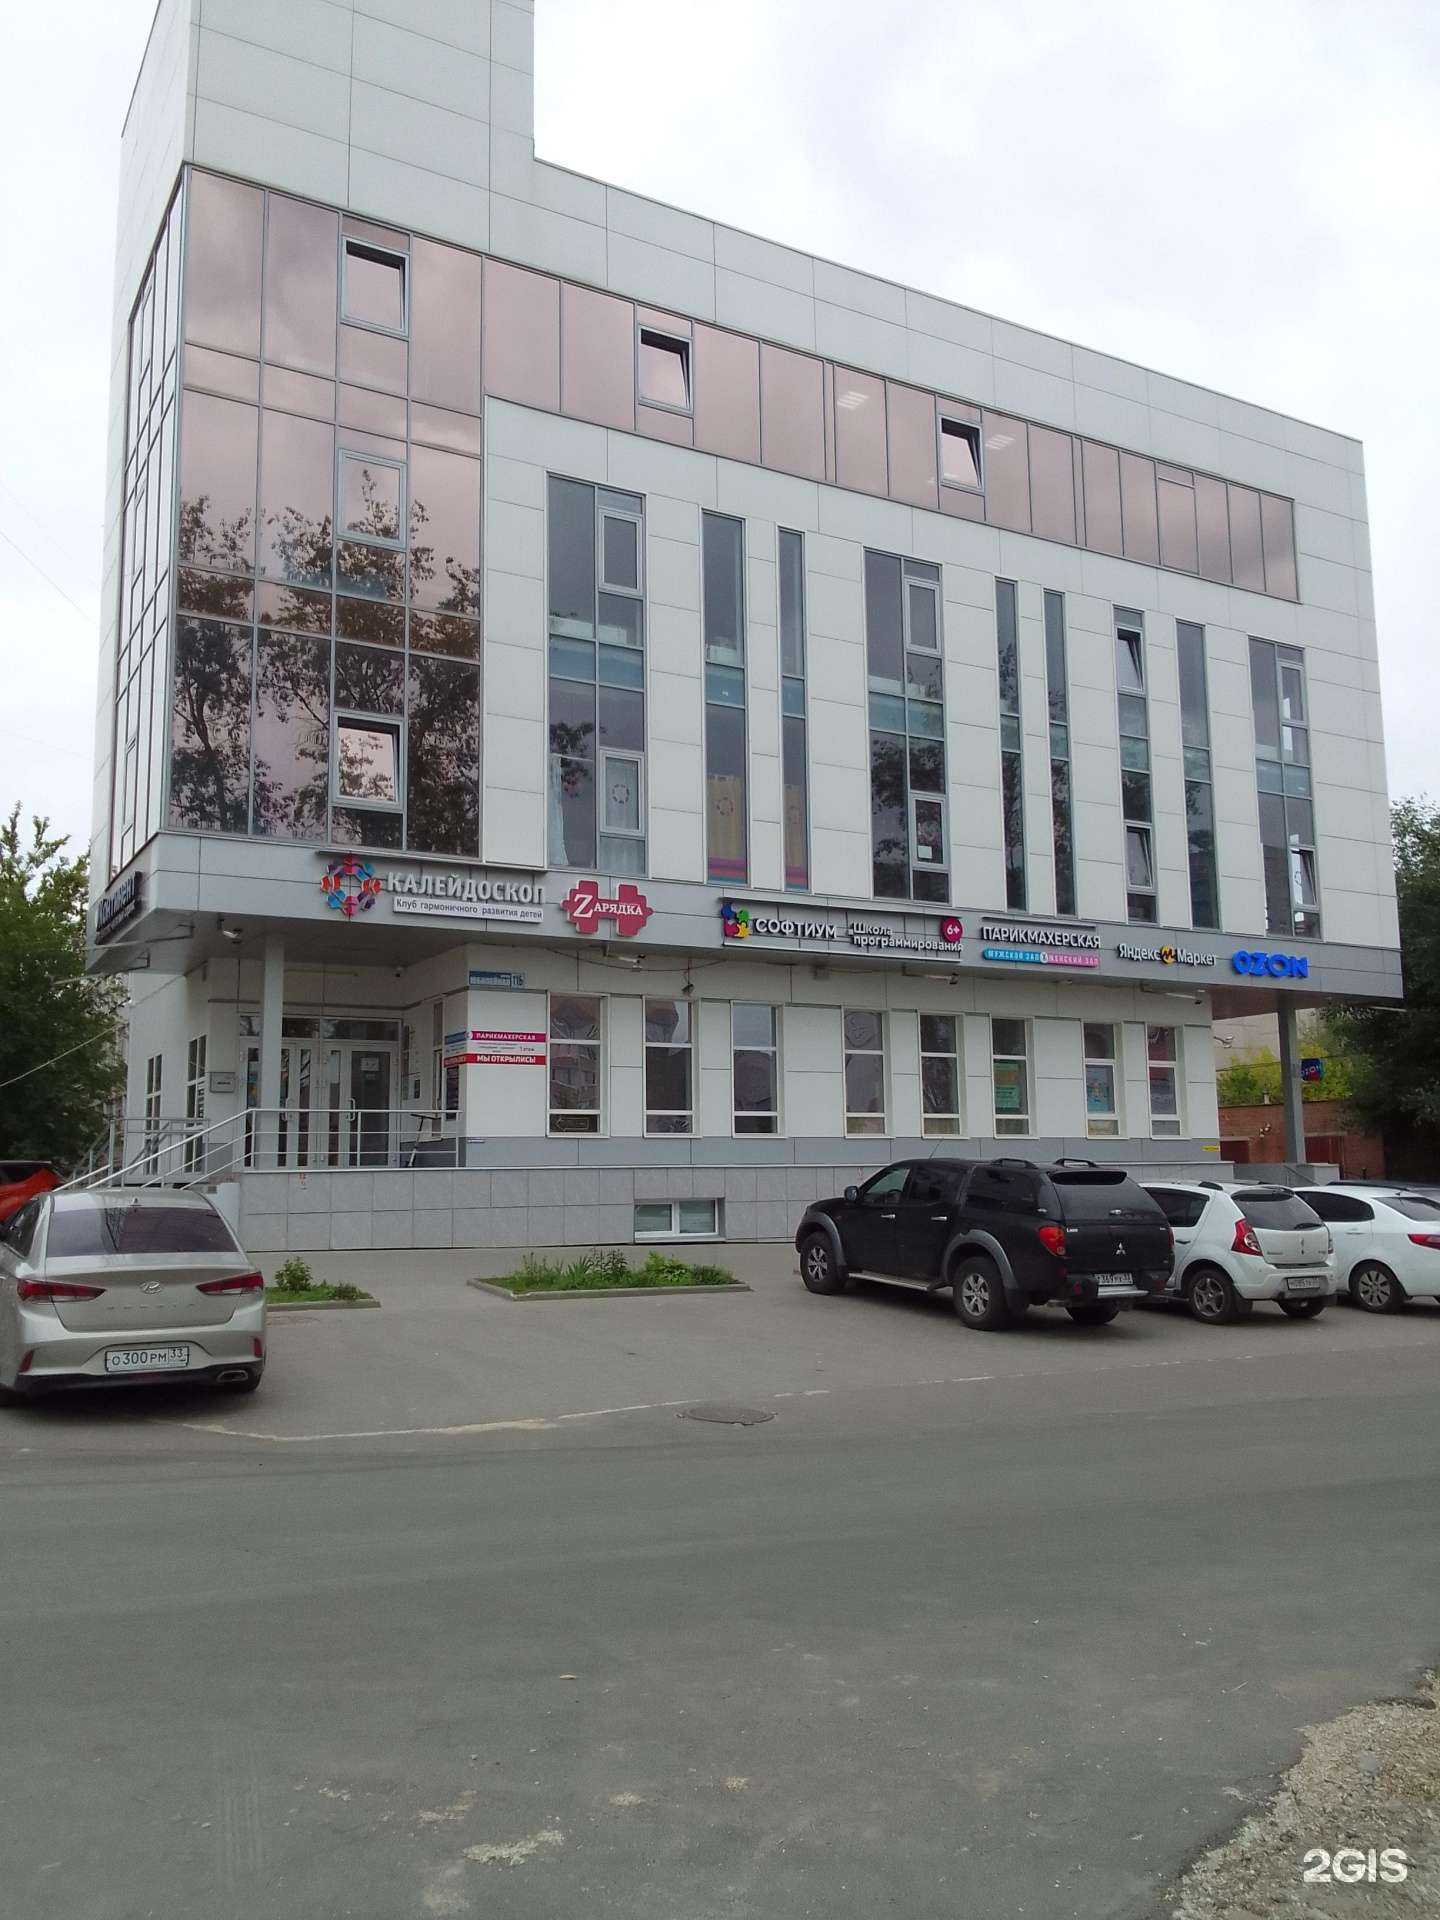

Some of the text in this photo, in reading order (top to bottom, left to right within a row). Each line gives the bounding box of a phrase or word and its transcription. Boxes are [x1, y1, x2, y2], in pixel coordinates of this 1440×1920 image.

[387, 871, 545, 904] КАЛЕЙДОСКОП
[396, 899, 543, 920] Клуб гармоничного развития детей
[755, 918, 837, 939] СОФТИУМ
[853, 922, 893, 936] Школа
[946, 924, 961, 935] 6+
[983, 926, 1101, 949] ПАРИКМАХЕРСКАЯ
[854, 935, 964, 952] программирования
[1119, 943, 1218, 966] Яндекс Маркет
[1232, 949, 1309, 978] OZON
[476, 1032, 536, 1041] ПАРИКМАХЕРСКАЯ
[477, 1055, 490, 1063] МЫ
